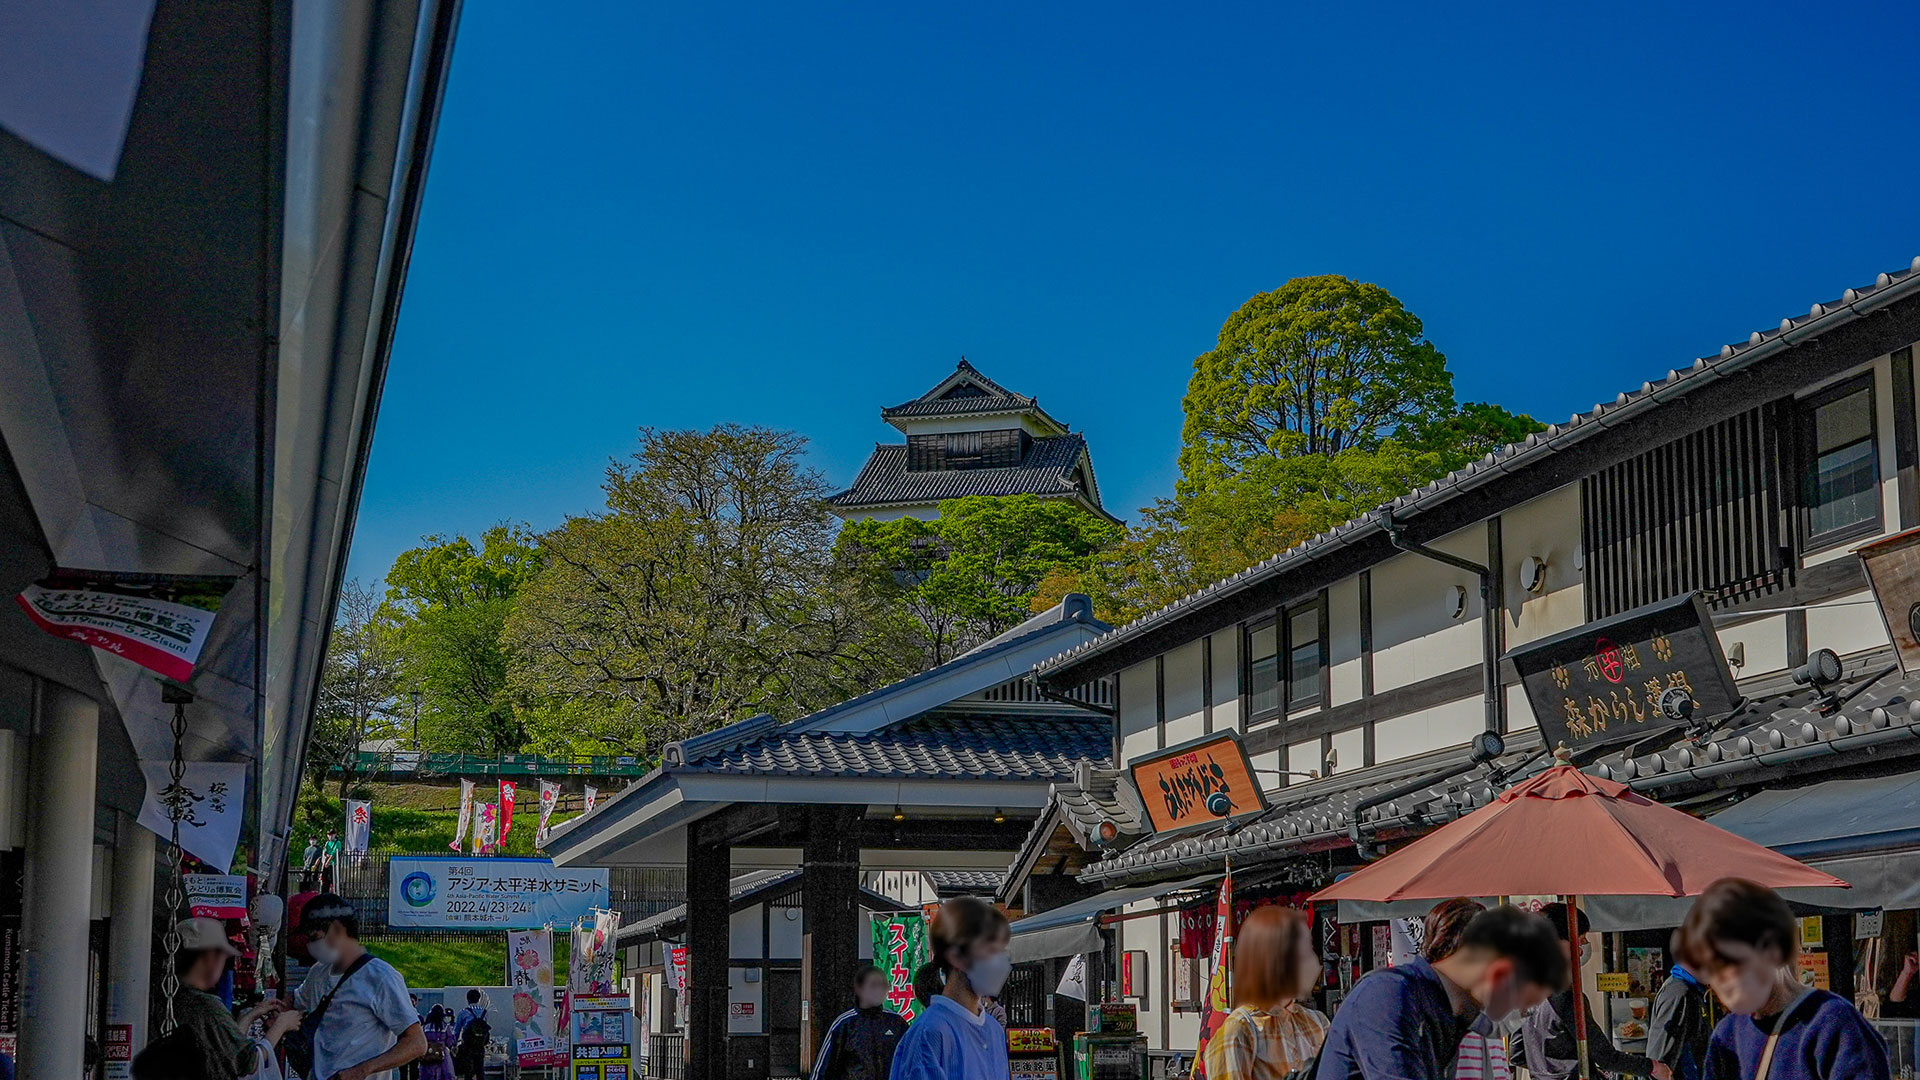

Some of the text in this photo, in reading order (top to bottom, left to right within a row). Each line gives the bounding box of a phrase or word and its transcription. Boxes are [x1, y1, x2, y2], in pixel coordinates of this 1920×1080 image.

[40, 592, 104, 603] くまもと
[353, 806, 368, 824] 祭
[448, 866, 473, 876] 第4回
[447, 877, 602, 893] アジア・太平洋水サミット
[1011, 1060, 1055, 1072] 肥後銘菓
